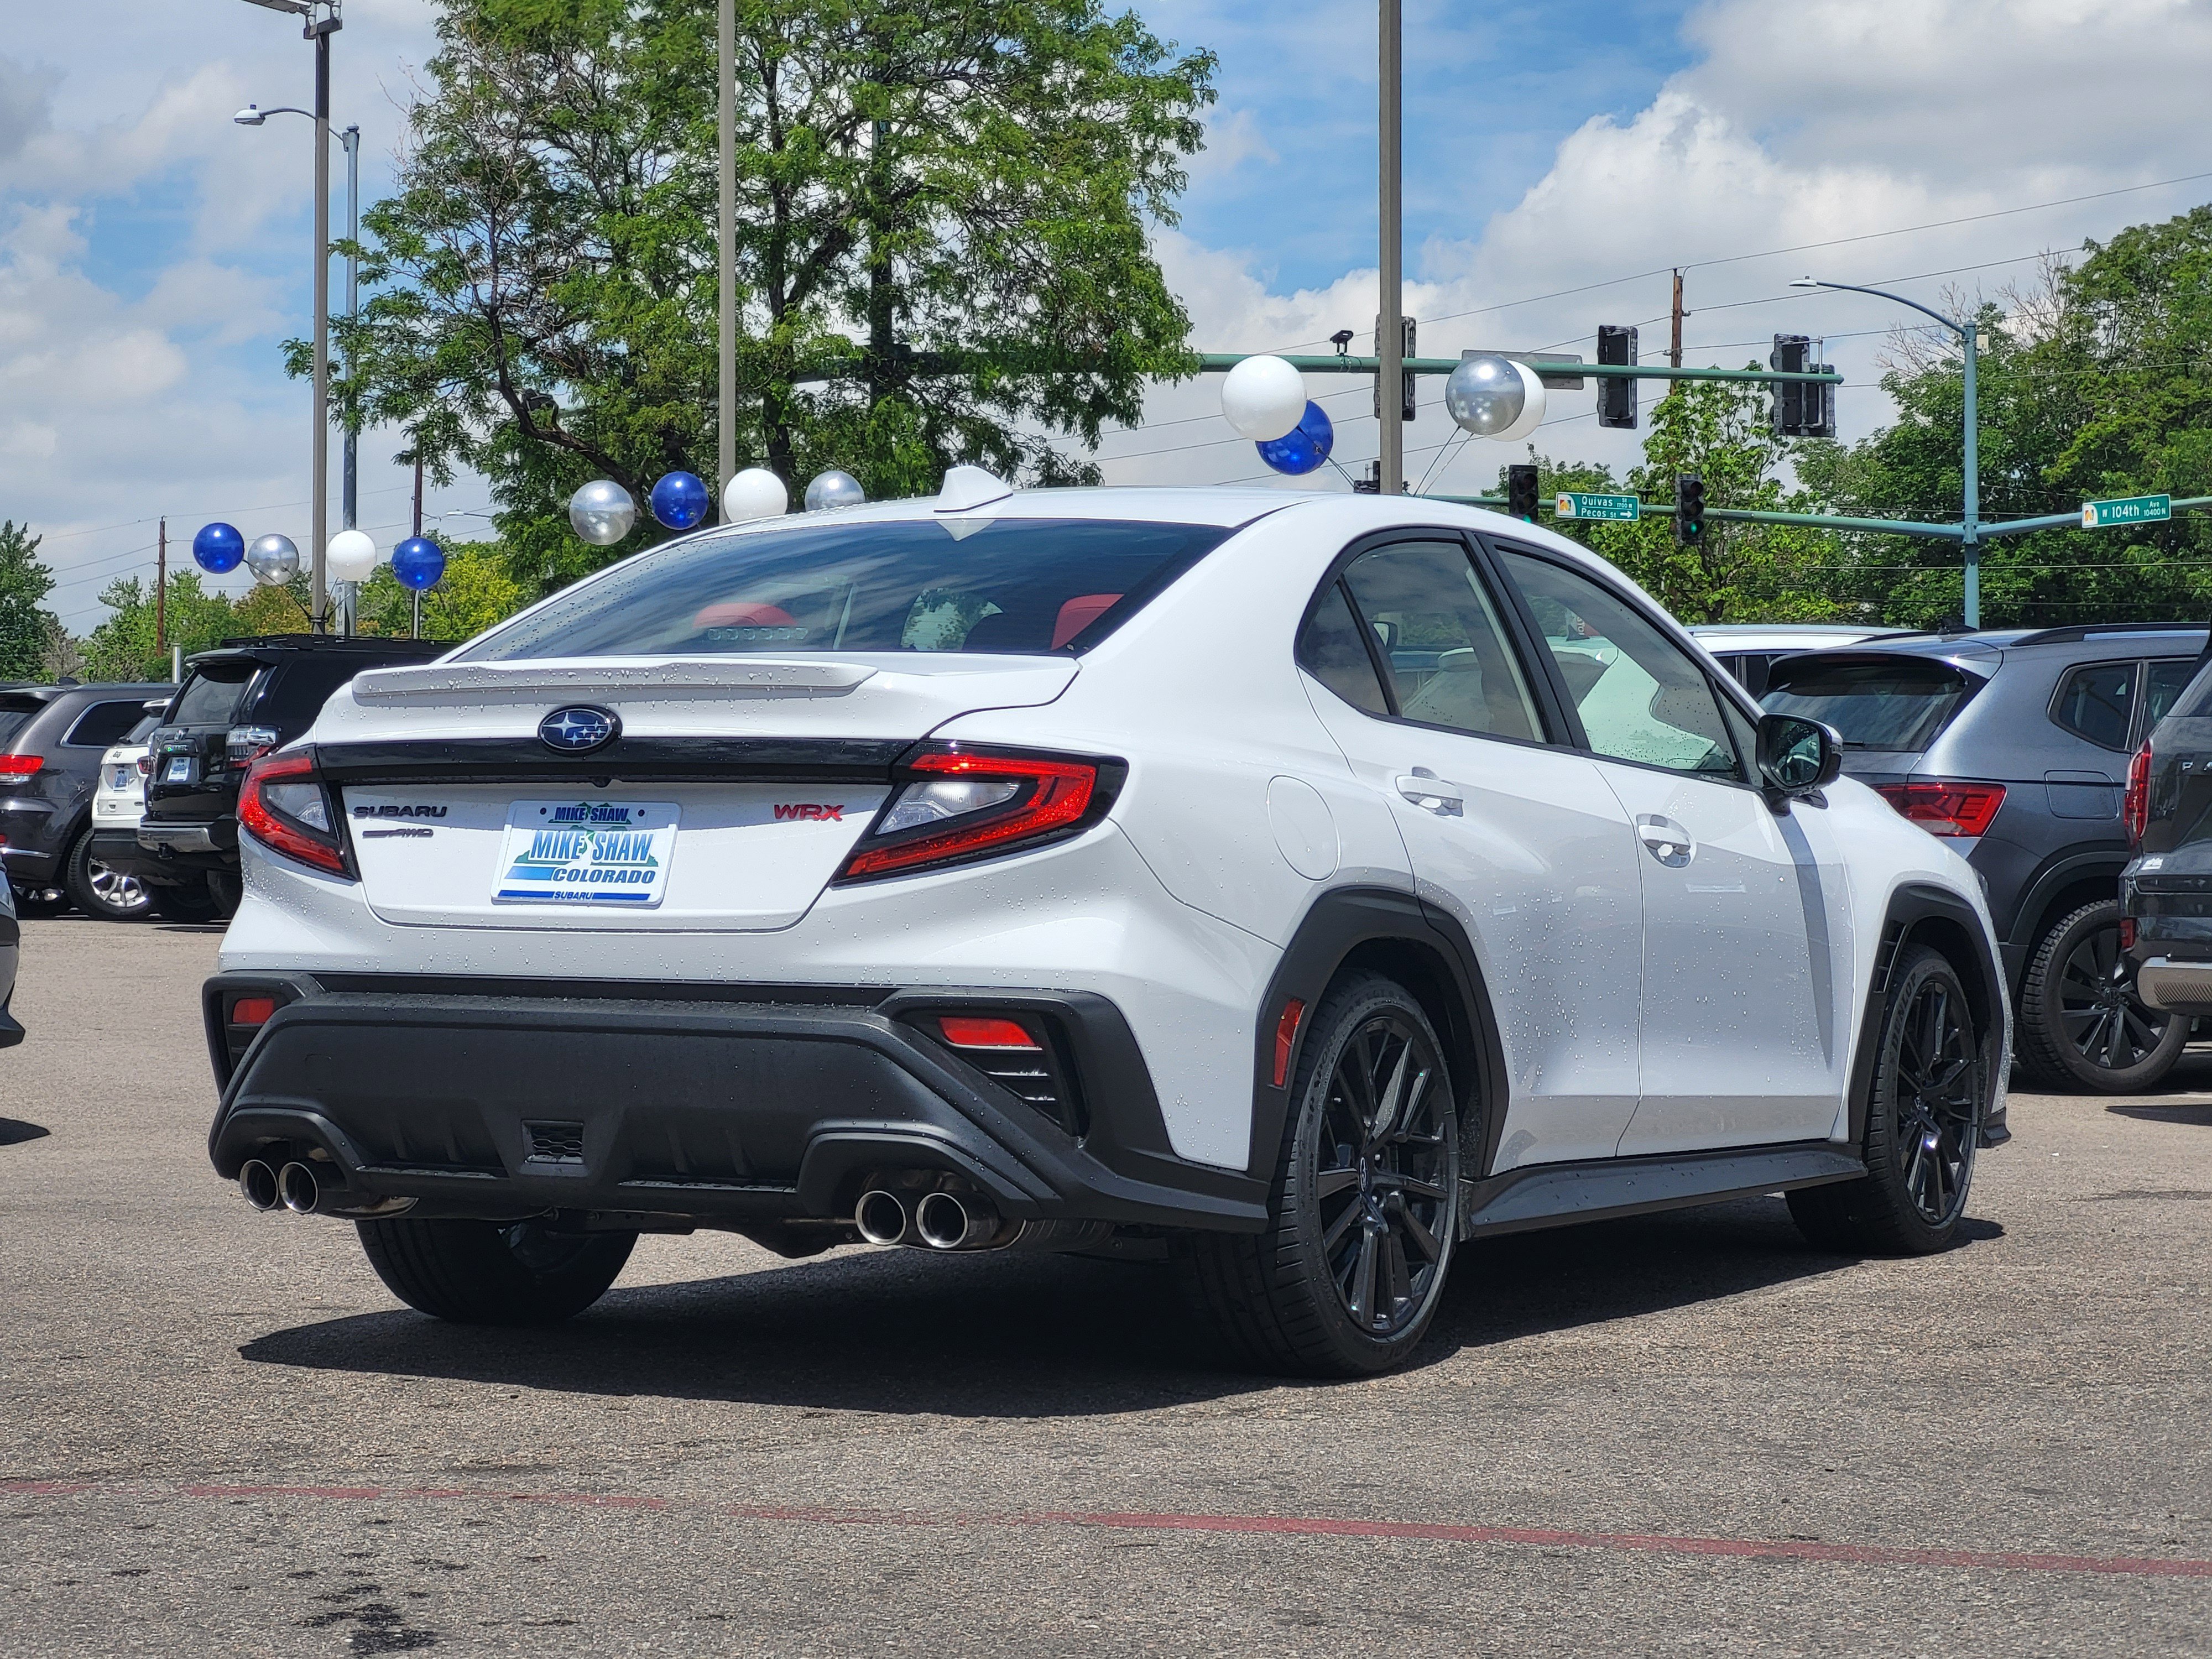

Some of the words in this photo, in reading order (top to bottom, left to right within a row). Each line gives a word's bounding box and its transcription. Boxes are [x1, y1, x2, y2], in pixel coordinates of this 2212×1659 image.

[1582, 495, 1613, 507] Quivas
[1581, 508, 1606, 517] Pecos
[2102, 509, 2107, 518] W
[2112, 504, 2140, 519] 104th
[353, 806, 447, 819] SUBARU
[555, 807, 586, 821] MIKE
[590, 807, 629, 821] SHAW
[774, 804, 844, 821] WRX
[388, 828, 434, 838] AWD
[530, 831, 585, 859] MIKE
[592, 832, 654, 861] SHAW
[553, 868, 656, 884] COLORADO
[554, 891, 593, 900] SUBARU
[1891, 972, 1916, 1051] DUNLOP
